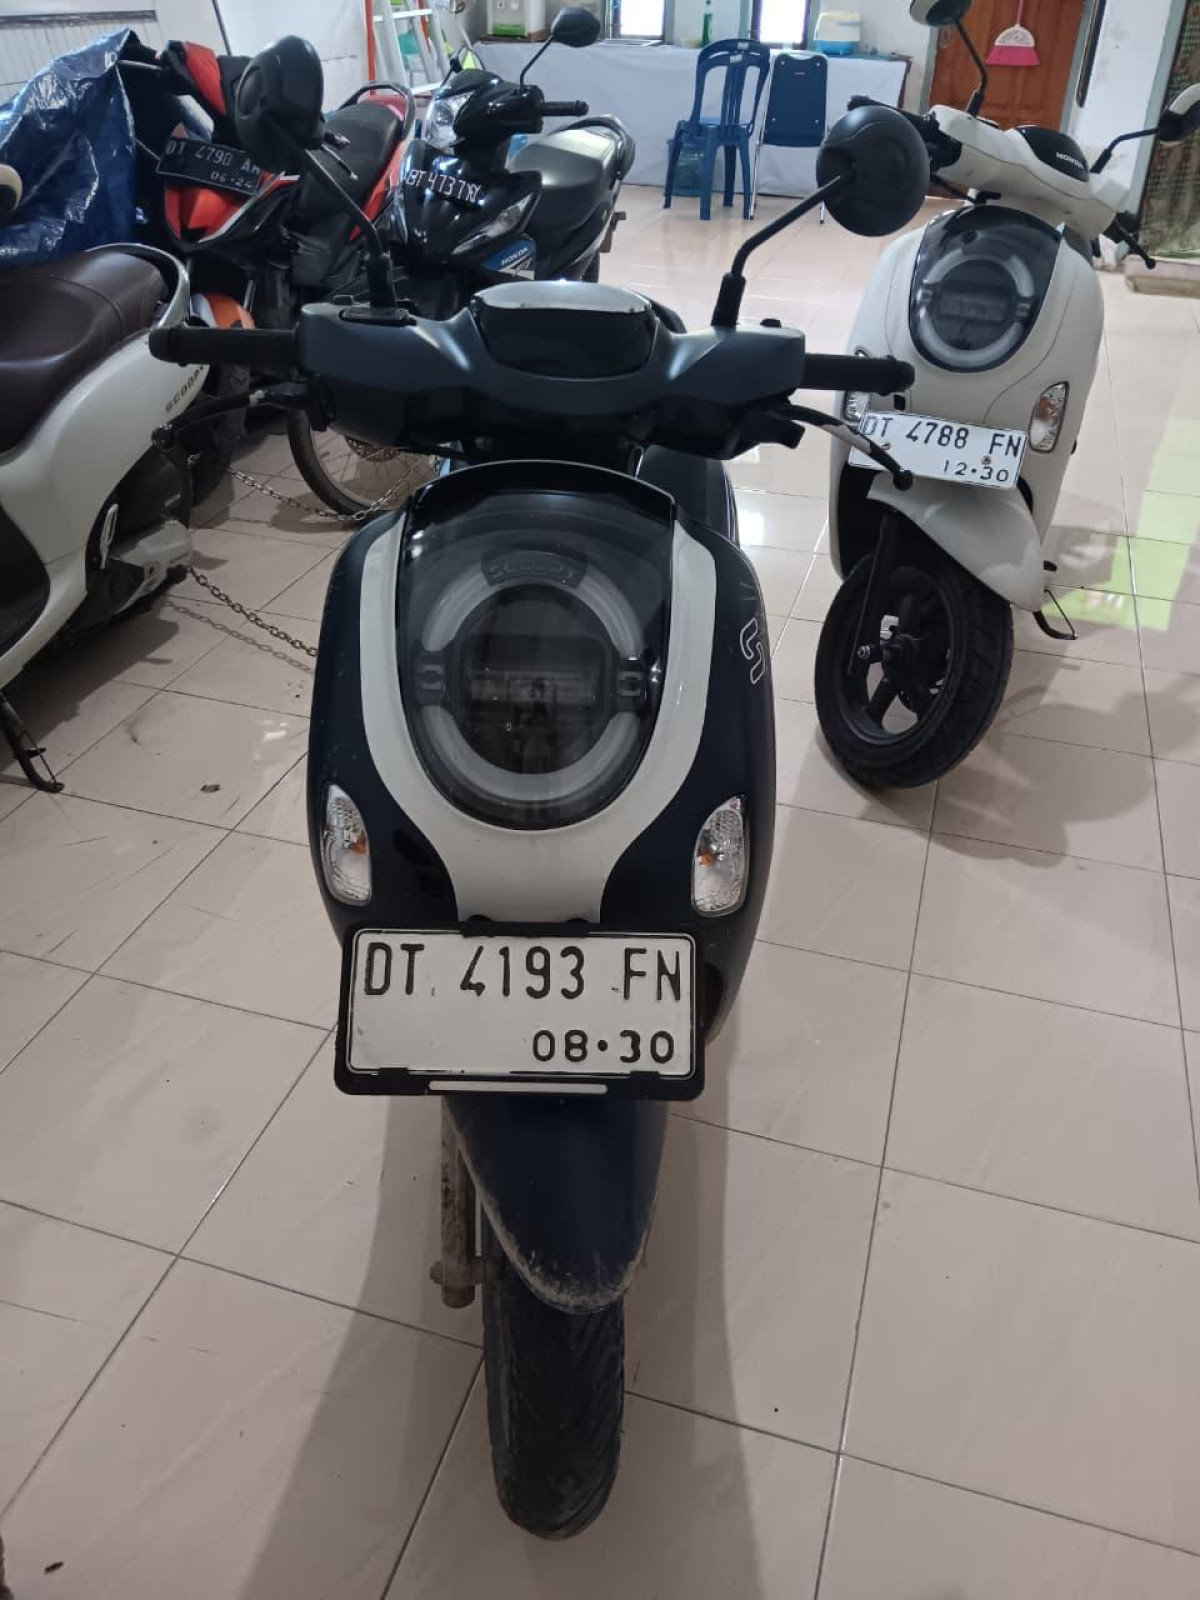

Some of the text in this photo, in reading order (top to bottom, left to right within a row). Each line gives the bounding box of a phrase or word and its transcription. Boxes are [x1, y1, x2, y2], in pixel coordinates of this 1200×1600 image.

[861, 415, 1022, 458] DT 4788 FN
[364, 942, 682, 1002] DT 4193 FN
